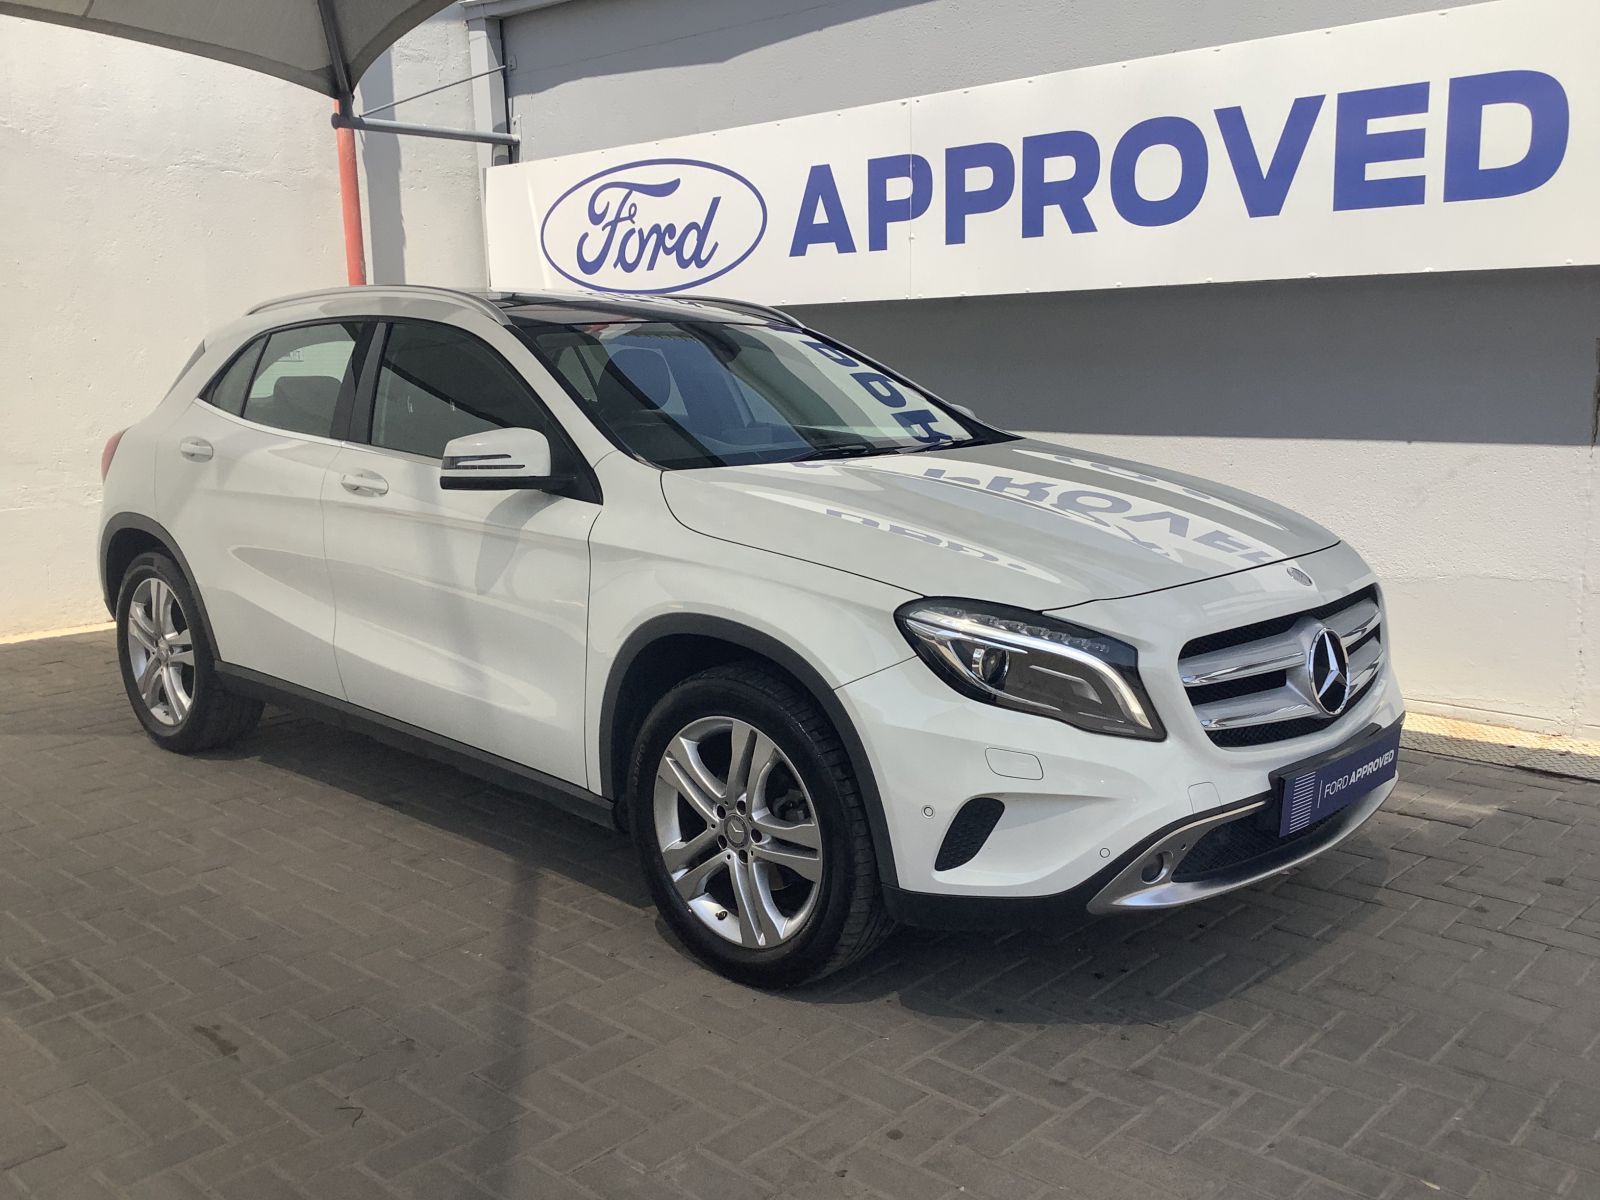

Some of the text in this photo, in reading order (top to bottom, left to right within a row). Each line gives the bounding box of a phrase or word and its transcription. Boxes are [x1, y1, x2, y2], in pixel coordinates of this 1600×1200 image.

[576, 70, 1570, 276] Ford APPROVED
[1324, 749, 1395, 798] FORD APPROVED
